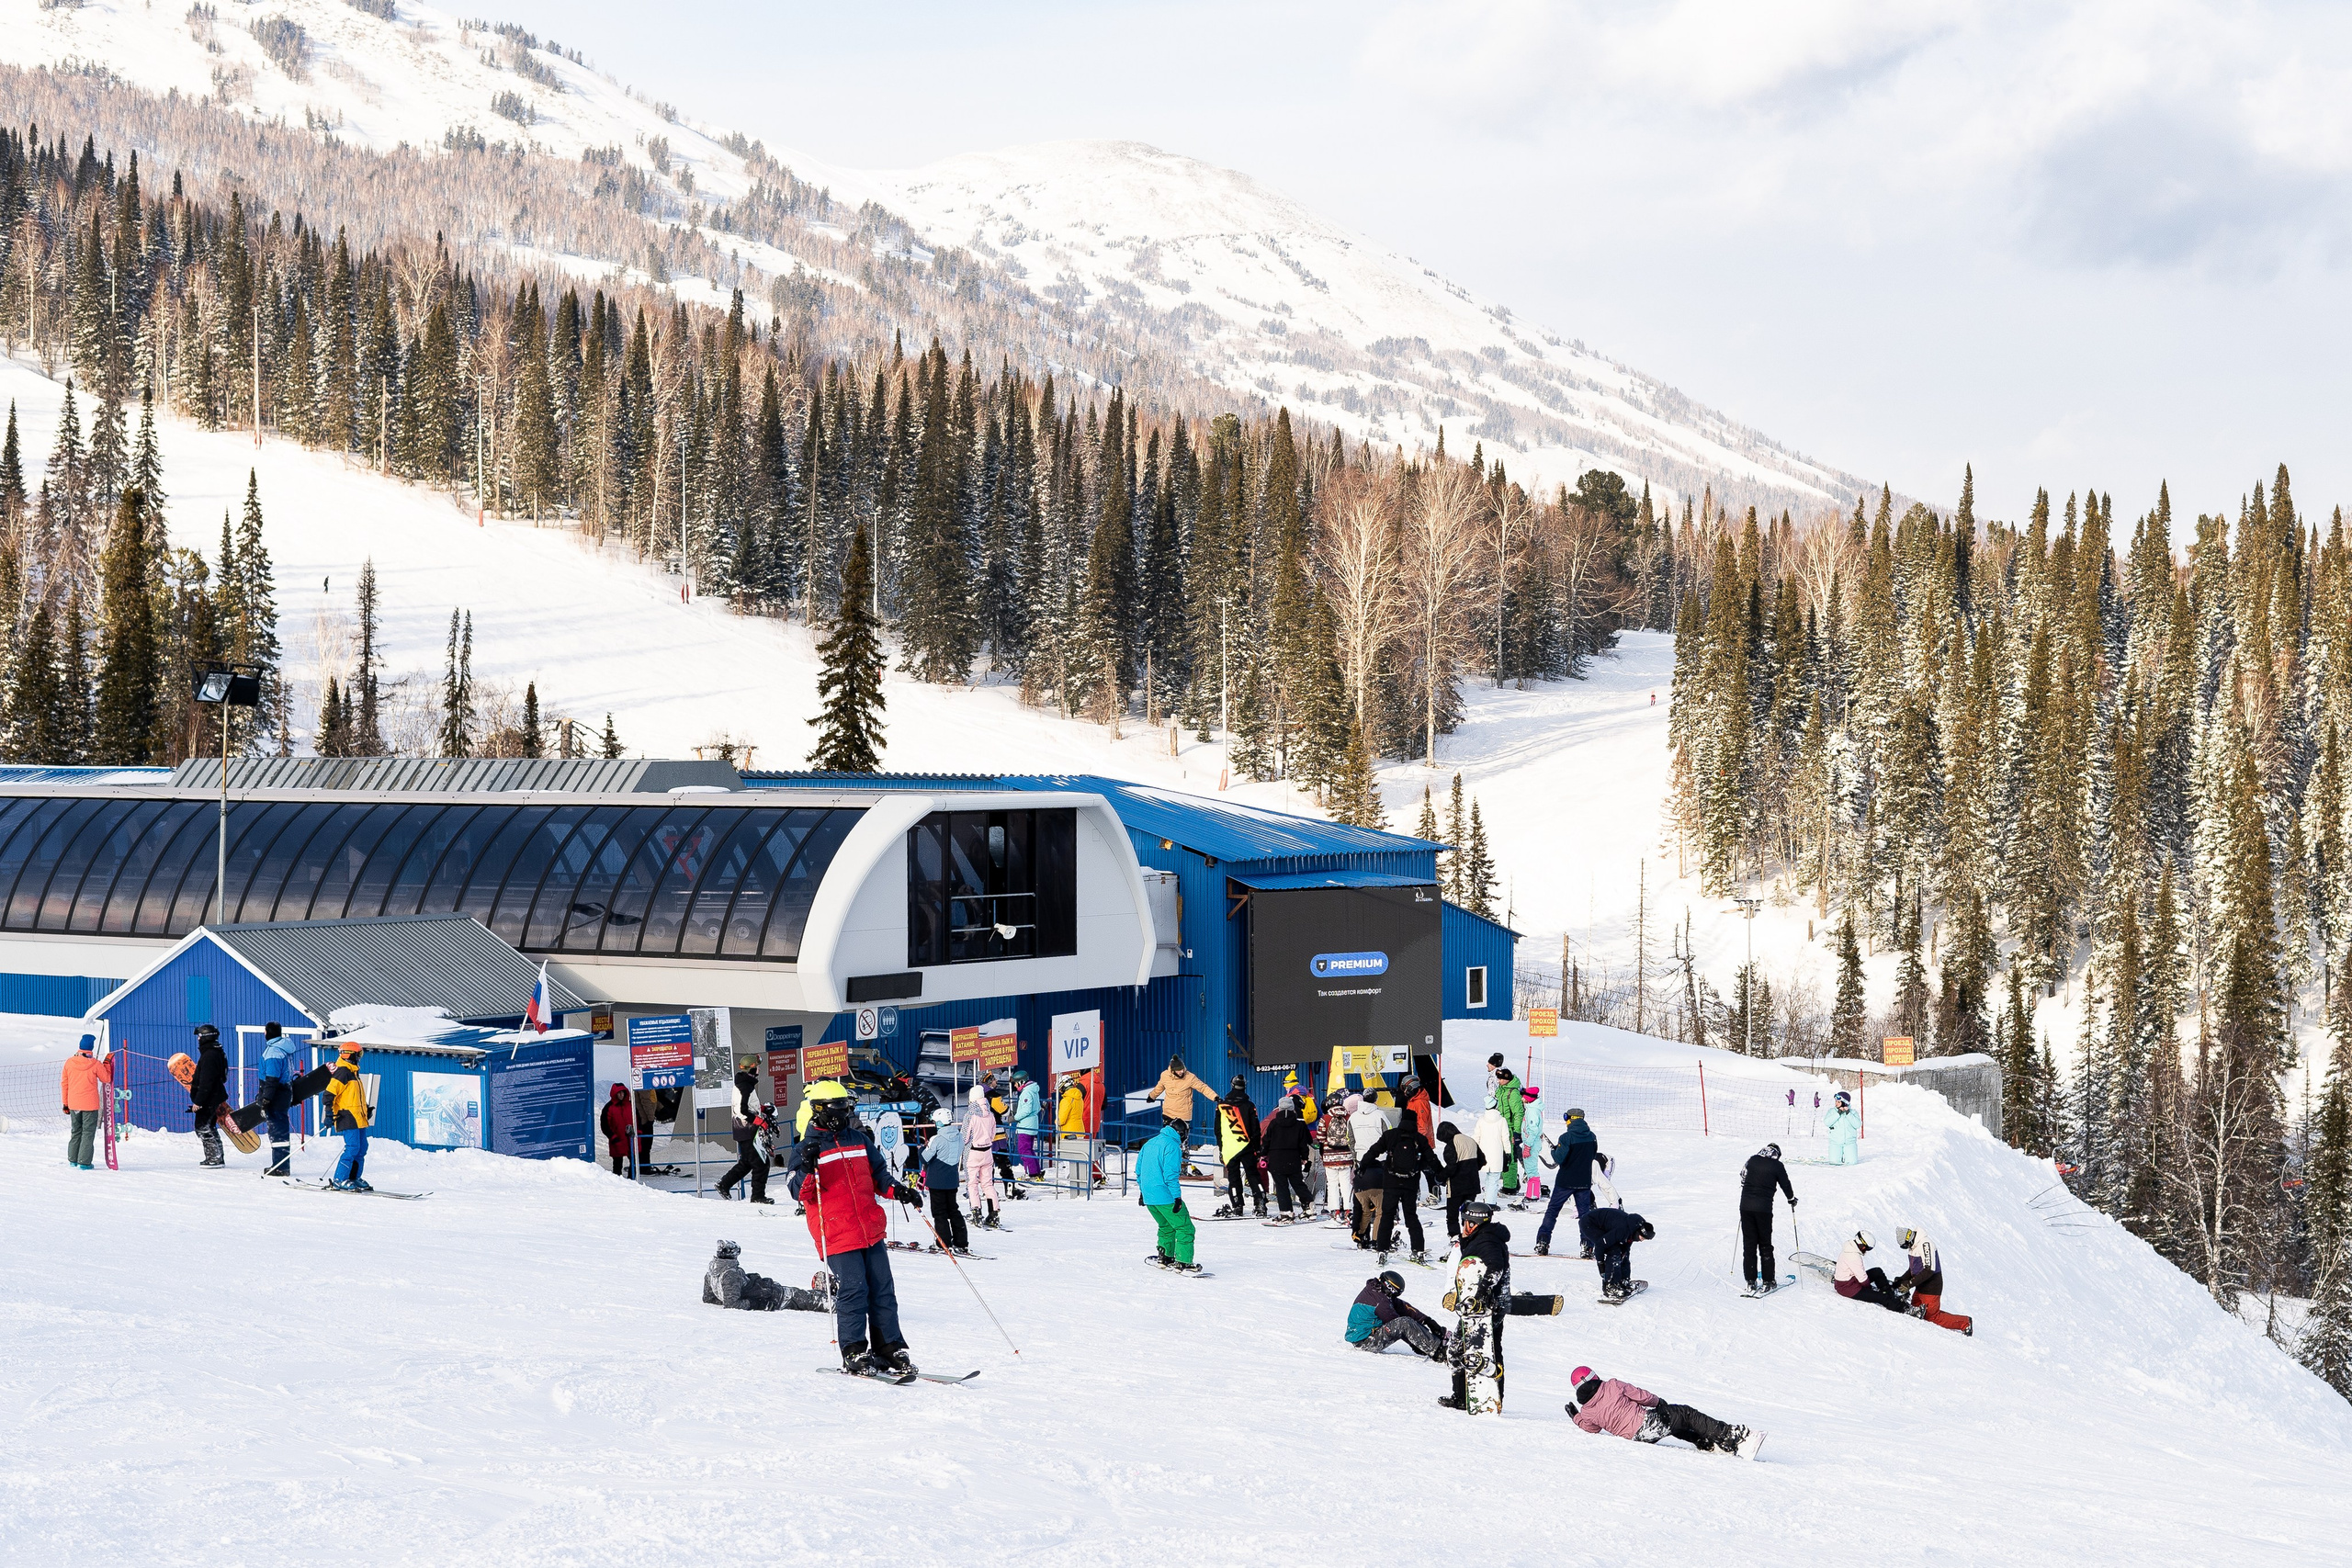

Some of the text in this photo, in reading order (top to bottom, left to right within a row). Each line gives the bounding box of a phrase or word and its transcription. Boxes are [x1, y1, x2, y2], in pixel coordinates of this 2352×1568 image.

[1330, 958, 1383, 970] PREMIUM
[1356, 987, 1382, 996] комфорт
[1530, 1025, 1557, 1035] ЗАПРЕЩЕН
[773, 1032, 801, 1041] Doppelmayr
[956, 1041, 975, 1049] КАТАНИЕ
[981, 1040, 1001, 1048] ПЕРЕВОЗКА
[1064, 1037, 1090, 1059] VIP
[807, 1048, 829, 1058] ПЕРЕВОЗКА
[830, 1046, 840, 1055] ЛЫЖ
[953, 1048, 978, 1058] ЗАПРЕЩЕНО
[979, 1048, 1002, 1057] СНОУБОРДОВ
[805, 1057, 830, 1068] СНОУБОРДОВ
[834, 1055, 846, 1063] РУКАХ
[985, 1054, 1012, 1066] ЗАПРЕЩЕНА
[1885, 1054, 1913, 1065] ЗАПРЕЩЕН
[810, 1064, 842, 1077] ЗАПРЕЩЕНА
[1256, 1064, 1296, 1072] 8-923-464-06-77
[1220, 1105, 1250, 1144] FXR
